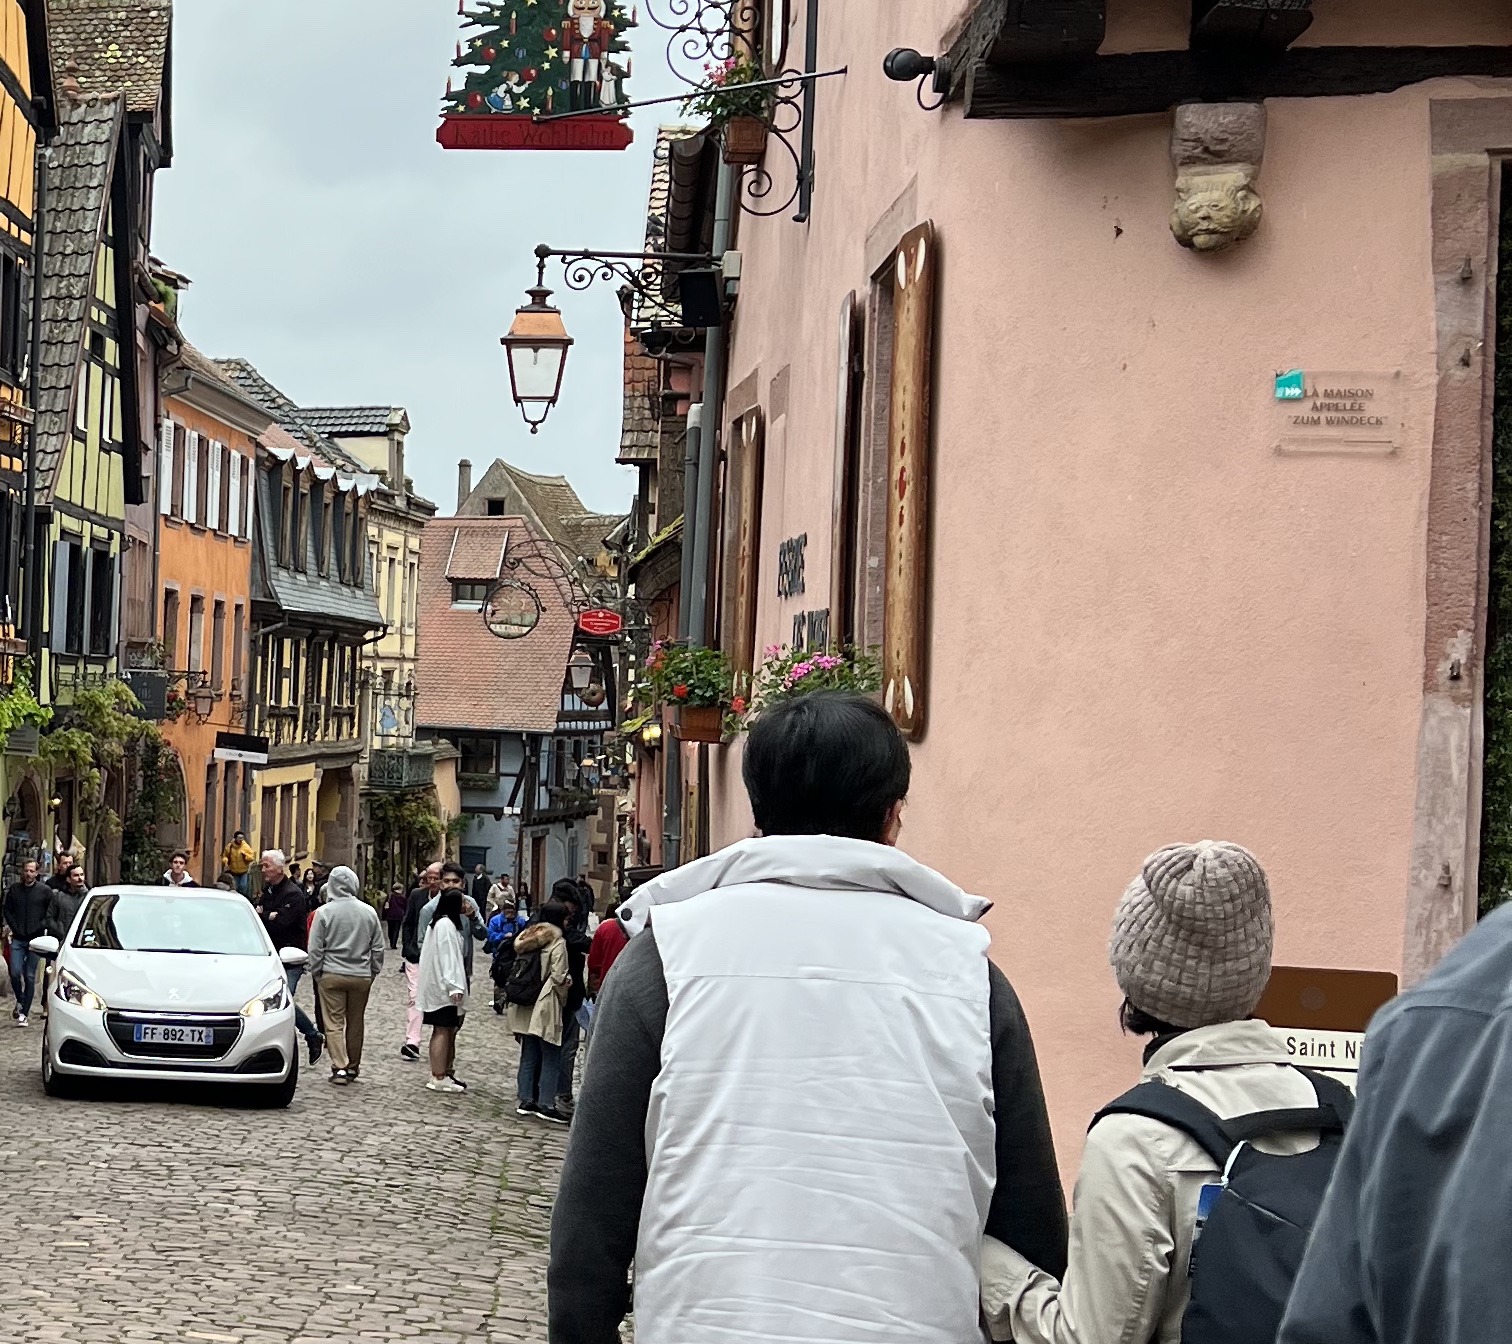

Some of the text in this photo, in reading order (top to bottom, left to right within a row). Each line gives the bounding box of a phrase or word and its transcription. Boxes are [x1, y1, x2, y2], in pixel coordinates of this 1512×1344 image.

[1324, 388, 1375, 398] MAISON
[143, 1026, 204, 1043] FF-892-TX
[1286, 1036, 1336, 1058] Saint
